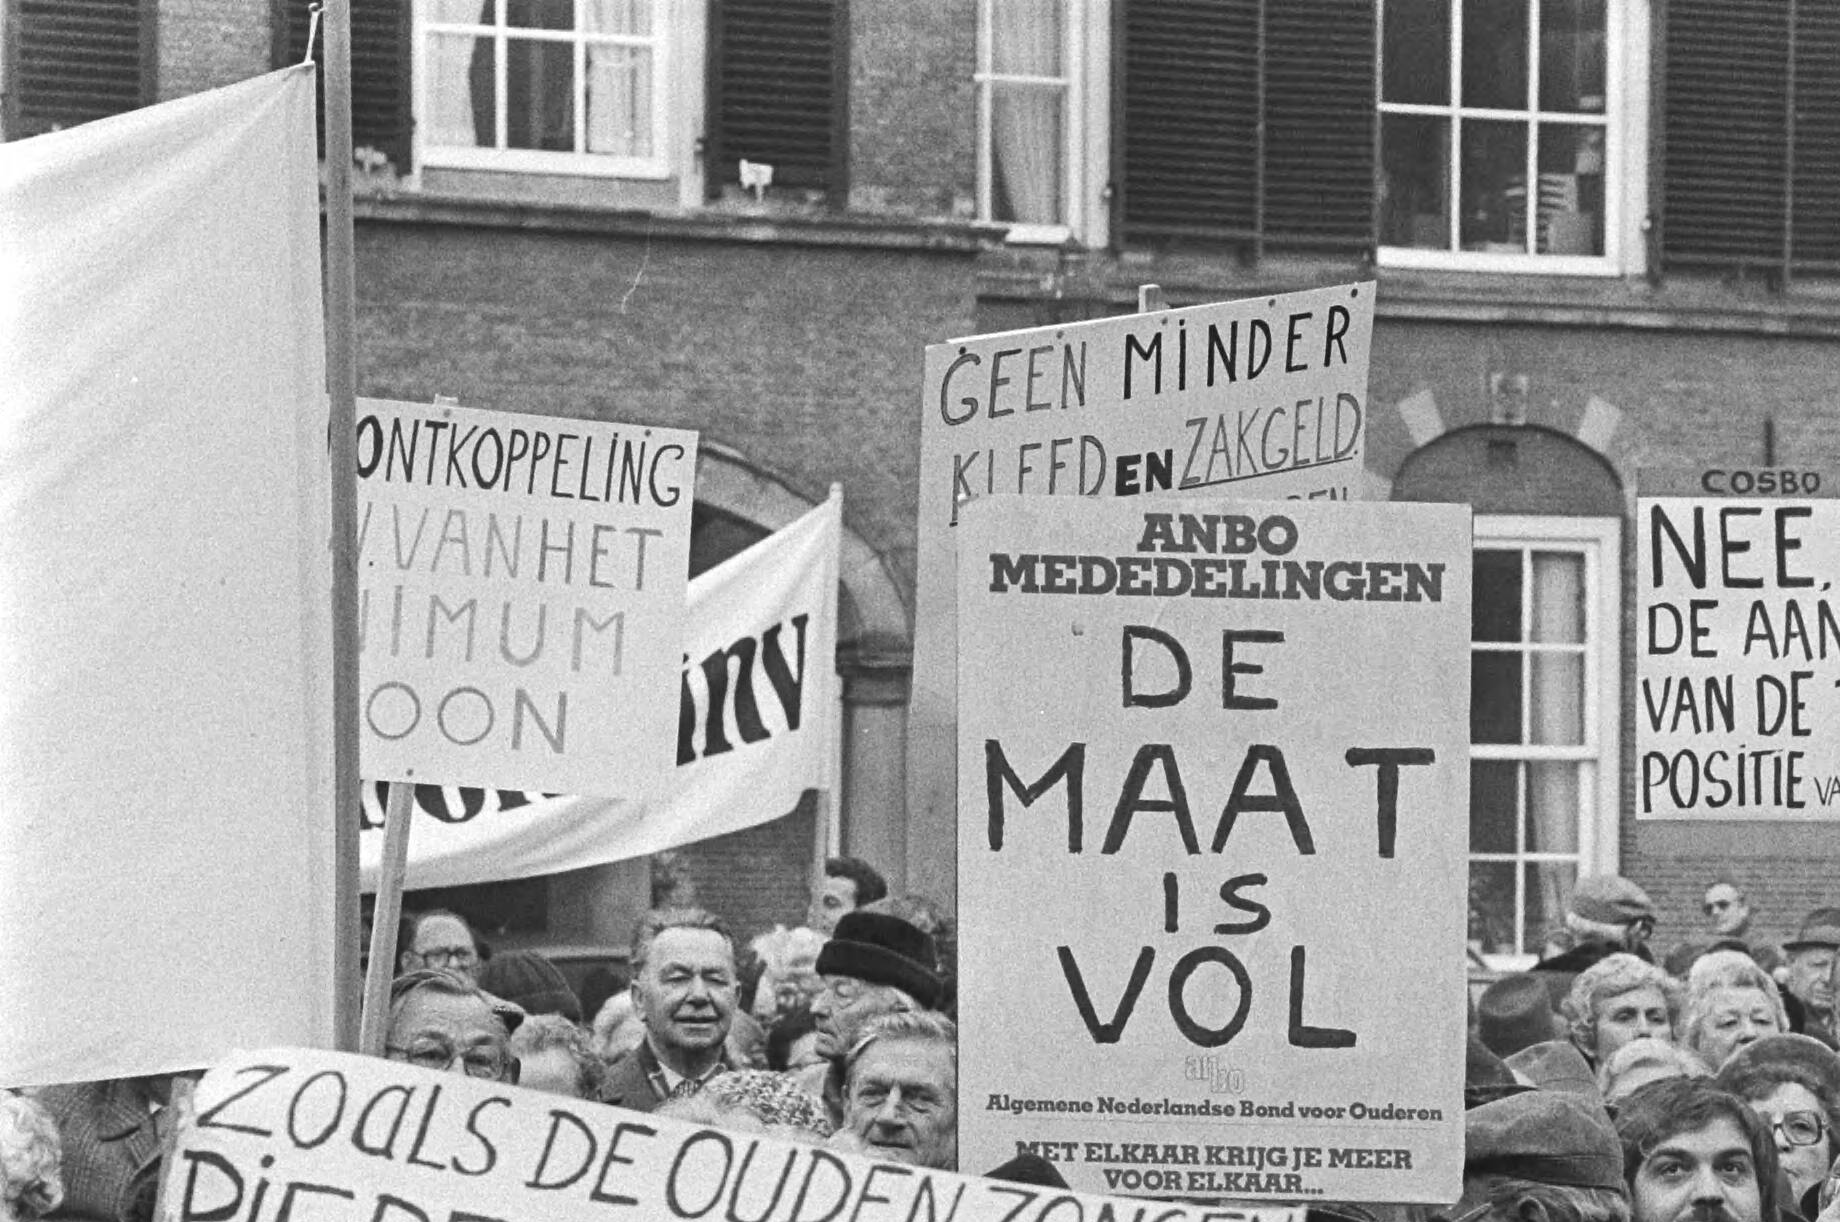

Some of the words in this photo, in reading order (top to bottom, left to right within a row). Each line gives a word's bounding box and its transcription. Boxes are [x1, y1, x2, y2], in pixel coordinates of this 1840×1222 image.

[940, 341, 1087, 426] GEEN
[1123, 304, 1351, 400] MINDER
[356, 414, 685, 507] ONTKOPPELING
[1114, 449, 1174, 497] EN
[1701, 468, 1821, 495] COSBO
[1137, 512, 1299, 556] ANBO
[989, 552, 1445, 603] MEDEDELINGEN
[1646, 600, 1719, 659] DE
[1122, 625, 1286, 711] DE
[1642, 674, 1736, 736] VAN
[1756, 670, 1815, 737] DE
[985, 738, 1436, 859] MAAT
[1642, 744, 1806, 814] POSITIE
[1163, 871, 1272, 935] IS
[1056, 944, 1357, 1049] VOL
[985, 1093, 1094, 1116] Algemene
[1096, 1096, 1236, 1118] Nederlandse
[1239, 1100, 1295, 1119] Bond
[1297, 1105, 1346, 1120] voor
[1348, 1102, 1443, 1123] Ouderen
[524, 1109, 659, 1206] DE
[1015, 1140, 1080, 1162] MET
[1083, 1142, 1200, 1166] ELKAAR
[1203, 1144, 1288, 1171] KRIJG
[1290, 1148, 1322, 1171] JE
[1327, 1149, 1414, 1170] MEER
[1103, 1167, 1185, 1191] VOOR
[1187, 1170, 1325, 1196] ELKAAR...
